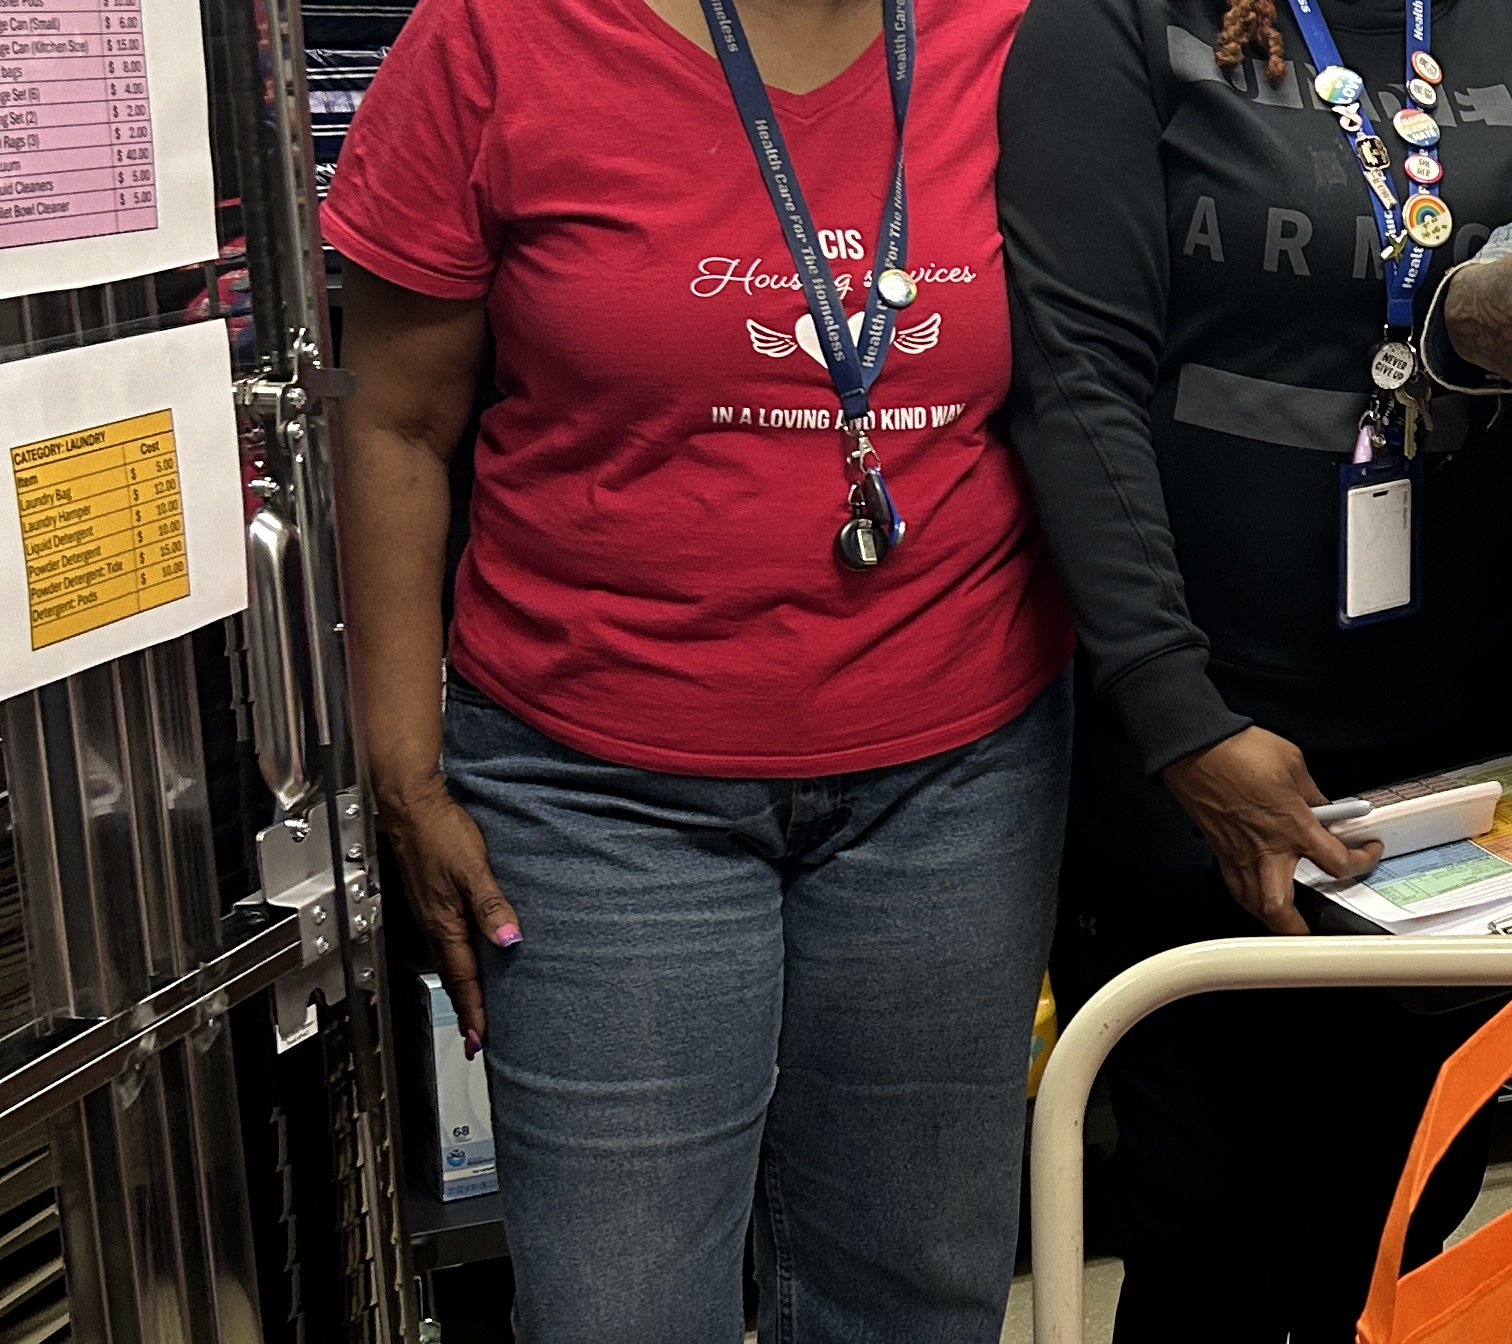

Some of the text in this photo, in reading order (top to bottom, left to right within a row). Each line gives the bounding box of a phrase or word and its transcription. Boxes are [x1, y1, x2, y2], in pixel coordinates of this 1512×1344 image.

[1413, 0, 1424, 41] Health
[896, 32, 906, 81] Health
[3, 135, 26, 151] Rags
[15, 180, 54, 194] Cleaners
[36, 201, 70, 215] Cleaner
[754, 119, 846, 363] Health Care For The Homeless
[690, 256, 855, 300] Housg
[861, 317, 885, 368] Health
[1375, 360, 1394, 377] GIVE
[1382, 352, 1408, 370] NEVER
[711, 403, 966, 430] IN A LOVING KIND WAY
[14, 431, 106, 466] CATEGORY: LAUNDRY
[140, 440, 161, 455] Cost
[17, 473, 38, 488] Item
[20, 487, 73, 511] Laundry Bag
[23, 504, 92, 533] Laundry Hamper
[26, 524, 95, 556] Liquid Detergent
[29, 545, 102, 579] Powder Detergent
[31, 580, 63, 600] Powder
[77, 590, 98, 605] Pods
[453, 1125, 470, 1137] 68
